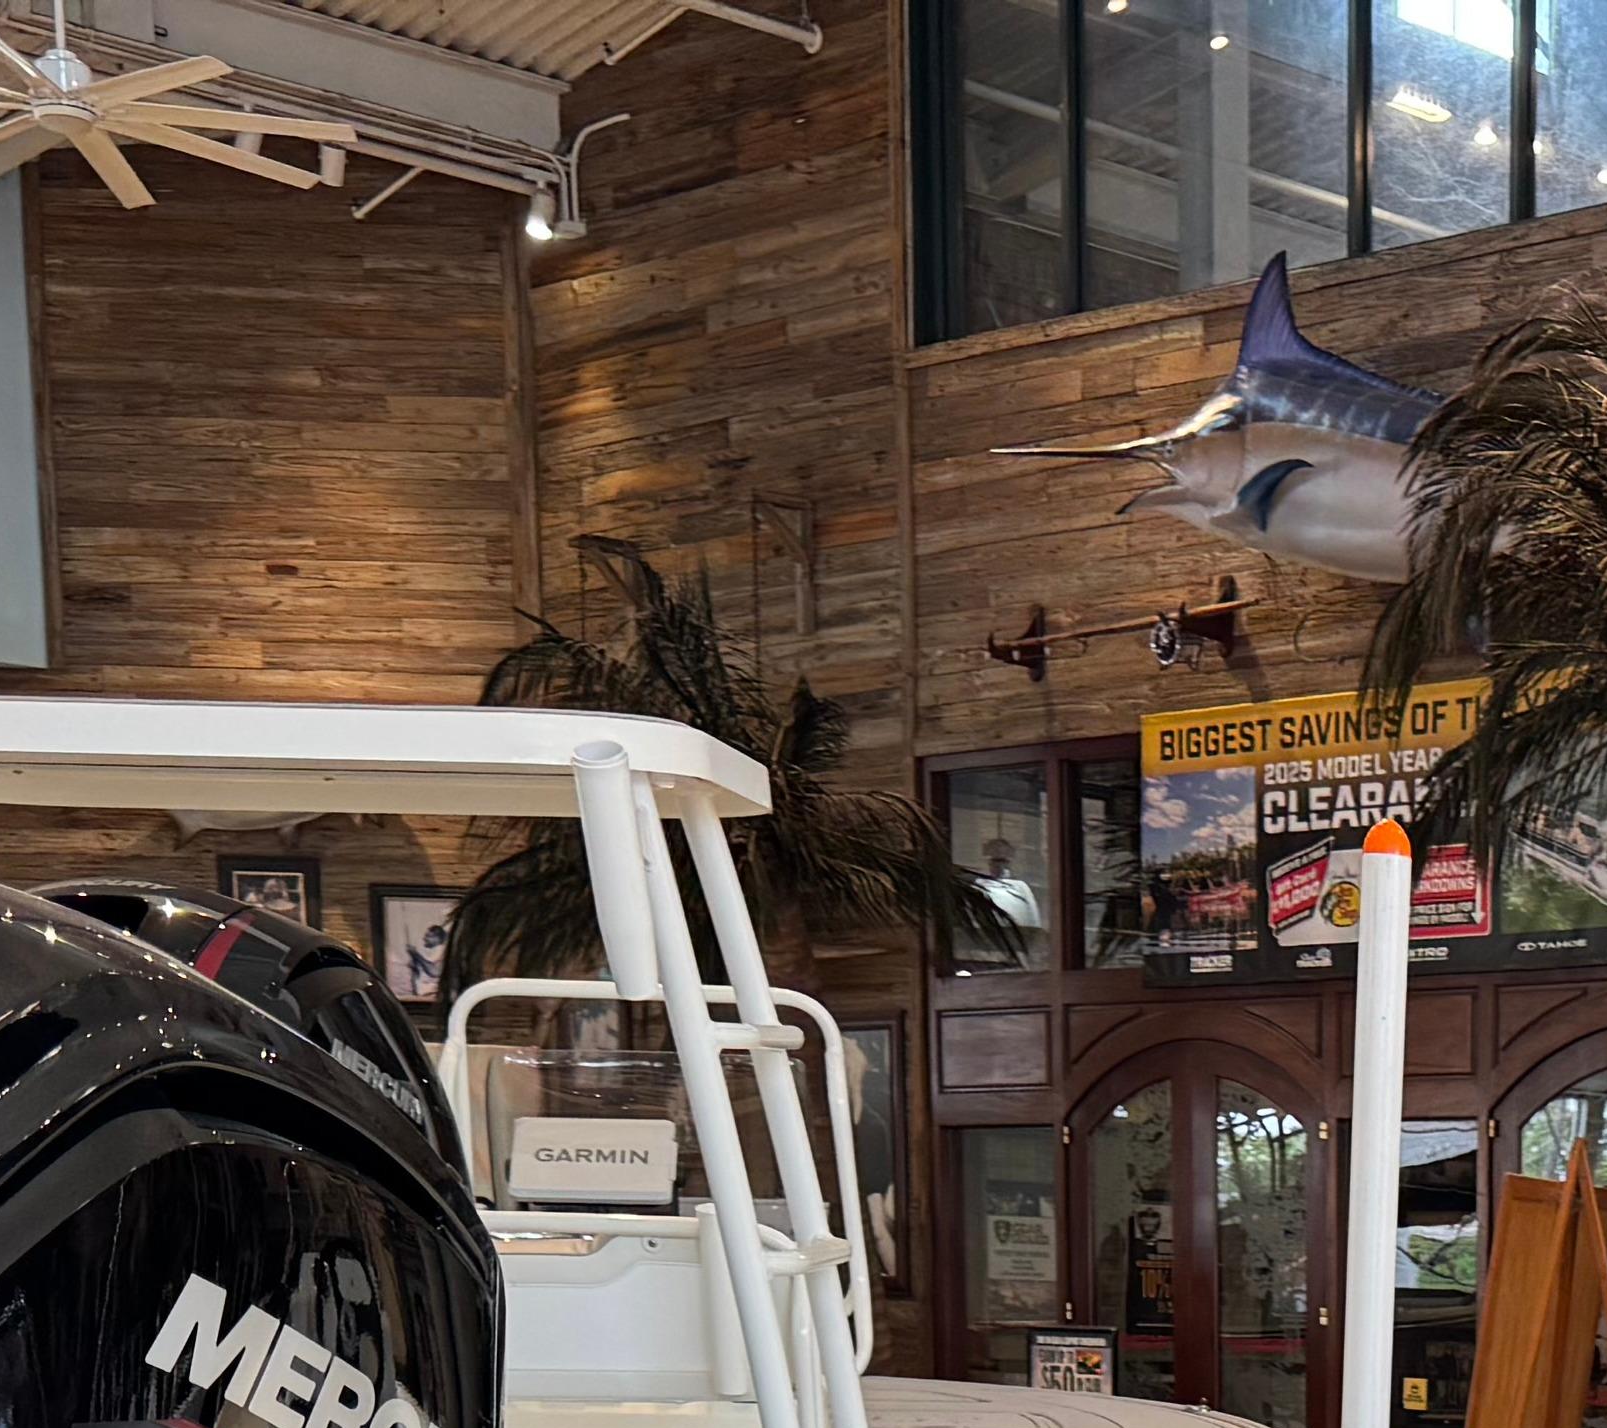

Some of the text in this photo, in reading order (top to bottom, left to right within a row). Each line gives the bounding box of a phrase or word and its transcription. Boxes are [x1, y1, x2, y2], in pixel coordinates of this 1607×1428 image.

[1160, 718, 1272, 762] BIGGEST
[1279, 704, 1402, 749] SAVINGS
[1410, 699, 1449, 735] OF
[1263, 746, 1443, 785] 2025 MODEL YEAR
[534, 1147, 650, 1165] GARMIN
